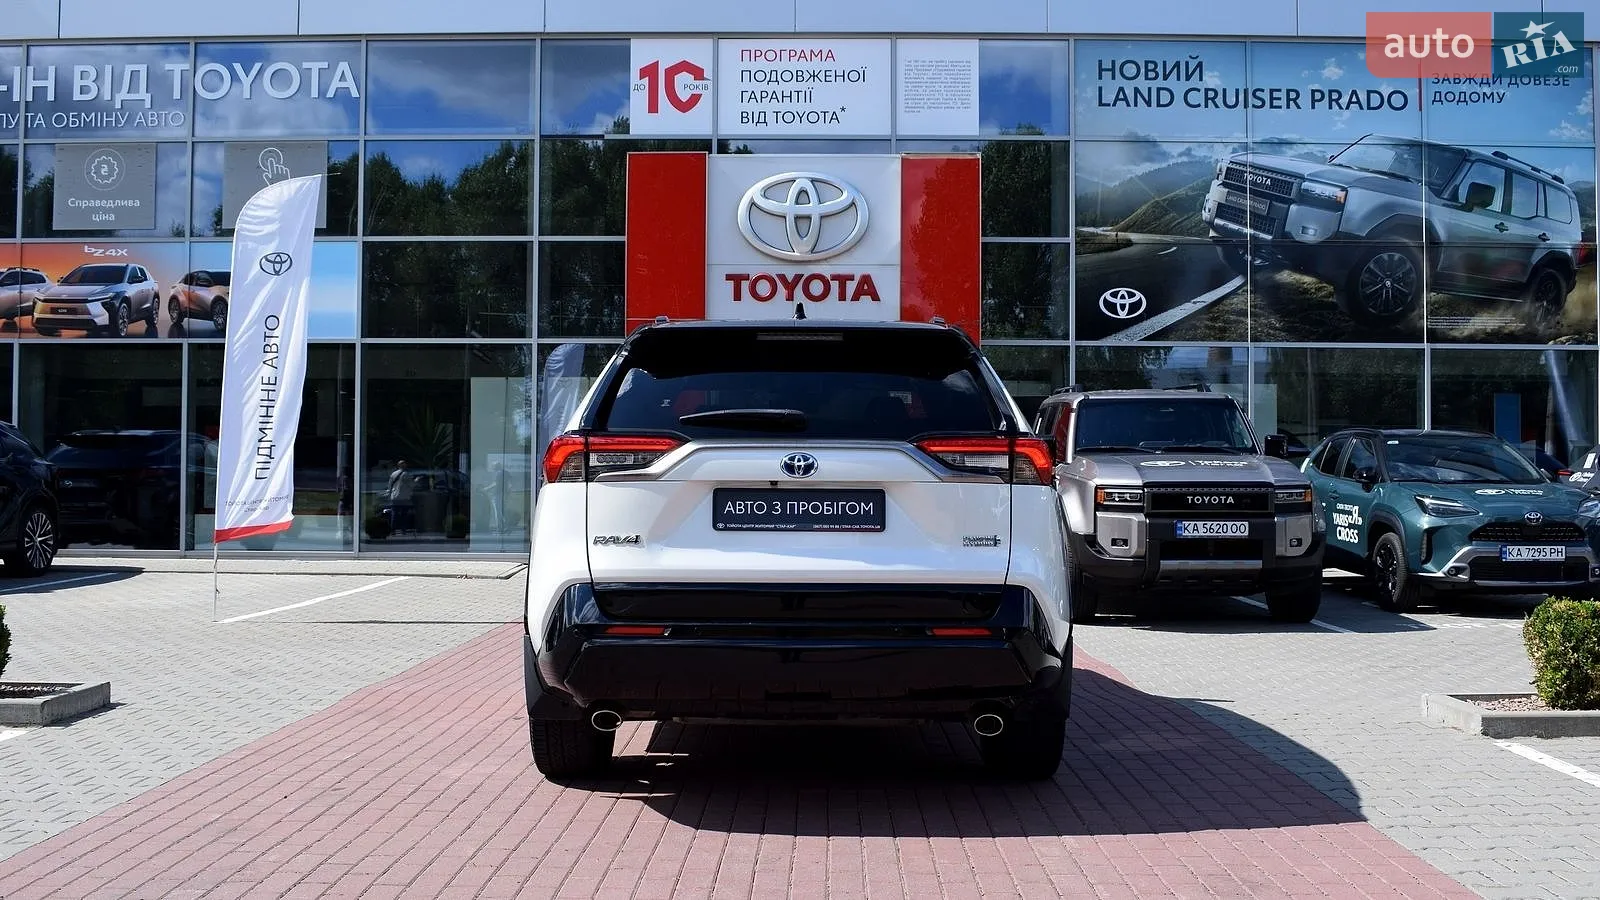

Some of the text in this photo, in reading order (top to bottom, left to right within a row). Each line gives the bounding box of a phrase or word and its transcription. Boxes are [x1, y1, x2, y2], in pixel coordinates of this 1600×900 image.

[740, 49, 836, 62] ПРОГРАМА
[740, 66, 868, 85] ПОДОВЖЕНОЇ
[1097, 55, 1204, 81] НОВИЙ
[72, 64, 152, 109] ВІД
[165, 61, 360, 100] TOYOTA
[632, 83, 646, 92] ДО
[683, 83, 709, 91] РОКІВ
[1431, 72, 1570, 88] ЗАВЖДИ ДОВЕЗЕ
[740, 87, 814, 103] ГАРАНТІЇ
[1098, 86, 1409, 111] LAND CRUISER PRADO
[1431, 91, 1506, 105] ДОДОМУ
[25, 112, 46, 129] ТА
[52, 112, 128, 128] ОБМІНУ
[134, 111, 185, 127] АВТО
[740, 111, 768, 127] ВІД
[1244, 173, 1271, 186] TOYOTA
[68, 198, 140, 209] Справедлива
[92, 211, 115, 222] ціна
[725, 272, 881, 302] TOYOTA
[255, 314, 280, 480] ПІДМІННЕ АВТО
[1187, 495, 1235, 504] TOYOTA
[724, 501, 767, 515] АВТО
[786, 501, 874, 516] ПРОБІГОМ
[1183, 523, 1200, 534] KA
[1203, 523, 1229, 534] 5620
[1336, 526, 1359, 544] CROSS
[592, 533, 642, 546] RAV4
[1508, 547, 1564, 558] KA 7295 PH
